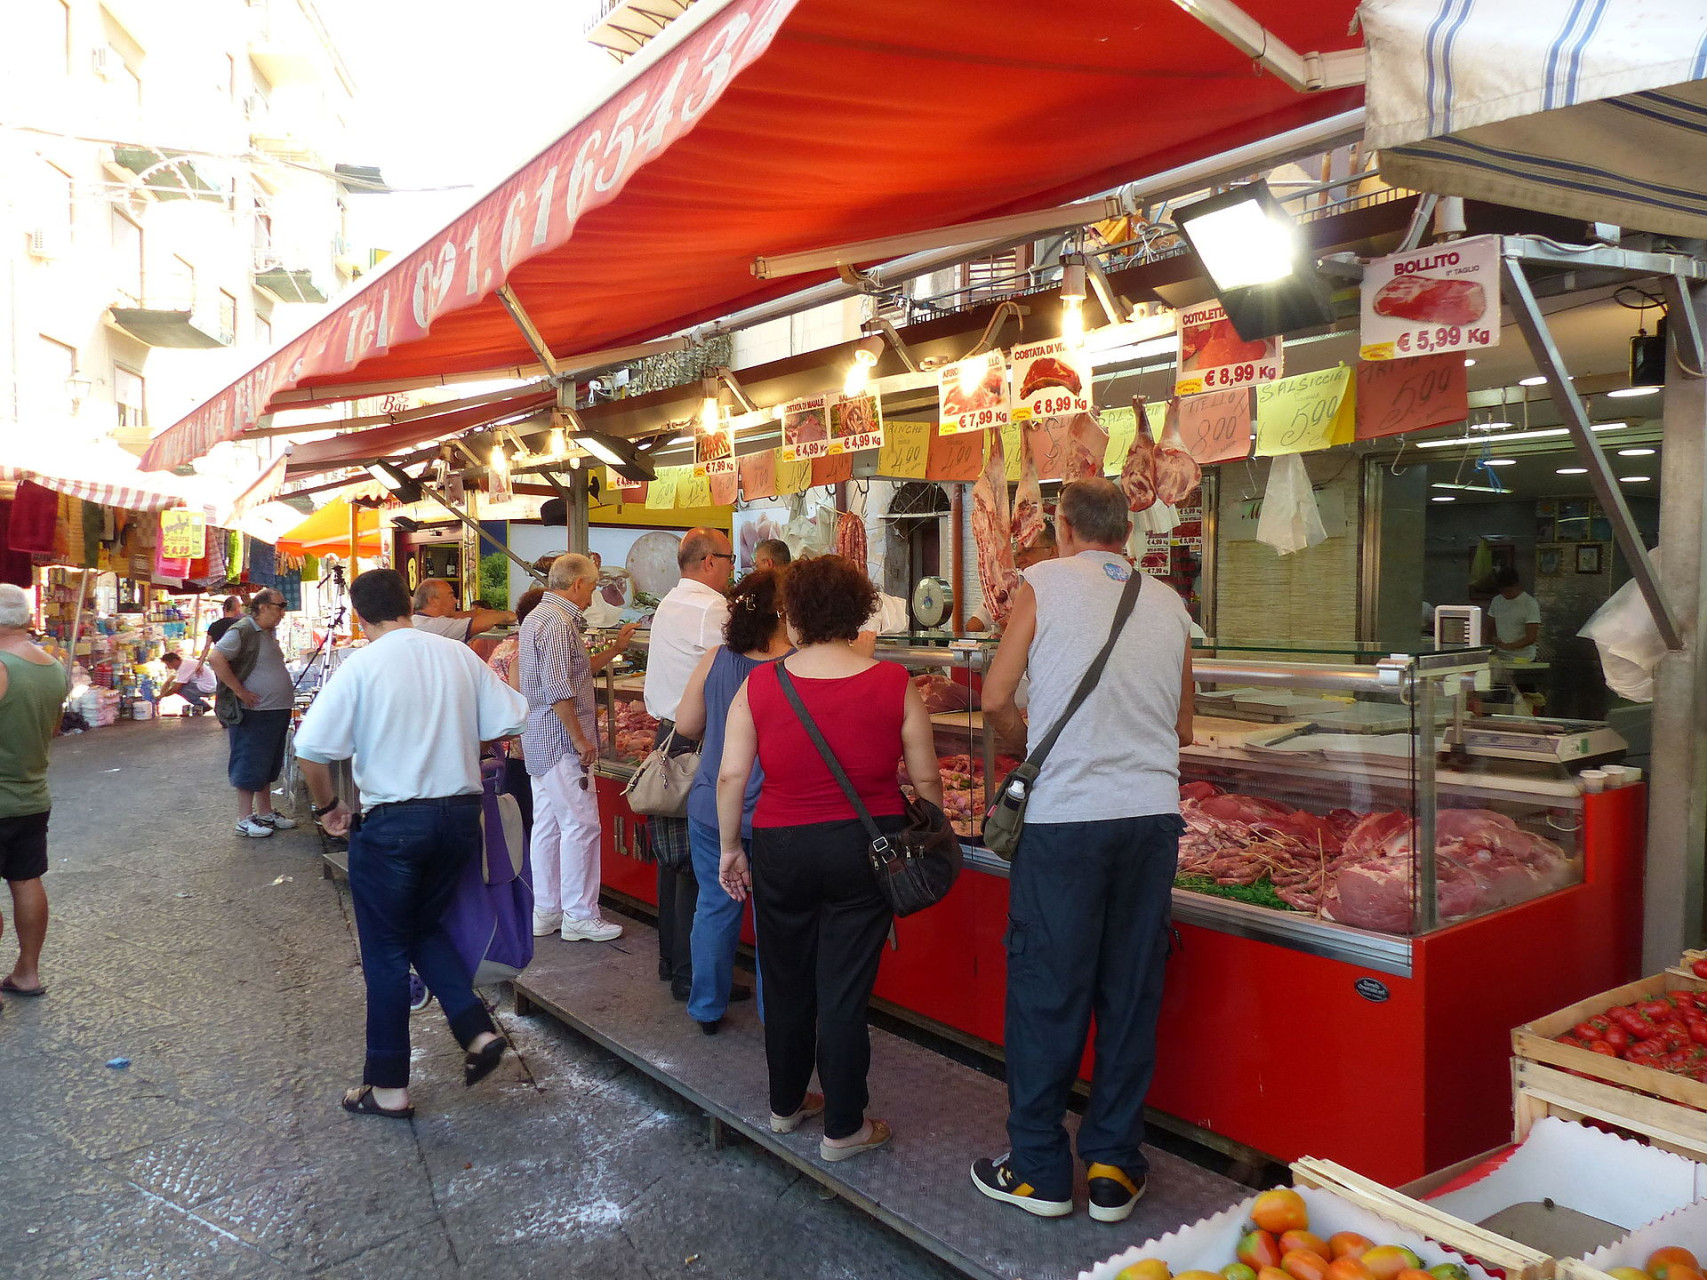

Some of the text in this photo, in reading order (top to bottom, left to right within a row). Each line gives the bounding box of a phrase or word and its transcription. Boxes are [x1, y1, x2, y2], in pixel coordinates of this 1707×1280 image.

[1394, 252, 1460, 276] BOLLITO
[1454, 264, 1480, 275] TAGLIO
[1397, 332, 1411, 352] €
[1416, 326, 1461, 352] 5,99
[1468, 328, 1490, 345] Kg
[1014, 345, 1045, 360] COSTATA
[1046, 345, 1054, 354] DI
[1204, 363, 1276, 387] € 8,99 Kg
[1260, 370, 1344, 403] SALSICCIA
[380, 395, 409, 413] Bar
[1033, 401, 1042, 415] €
[1045, 396, 1071, 415] 8,99
[1074, 398, 1088, 411] Kg
[958, 416, 967, 428] €
[969, 410, 993, 428] 7,99
[995, 411, 1008, 424] Kg
[795, 445, 801, 457] €
[802, 443, 819, 457] 4,99
[844, 437, 850, 449] €
[851, 434, 870, 450] 4,99
[872, 436, 881, 446] Kg
[706, 462, 711, 473] €
[711, 460, 726, 473] 7,99
[726, 462, 734, 471] Kg
